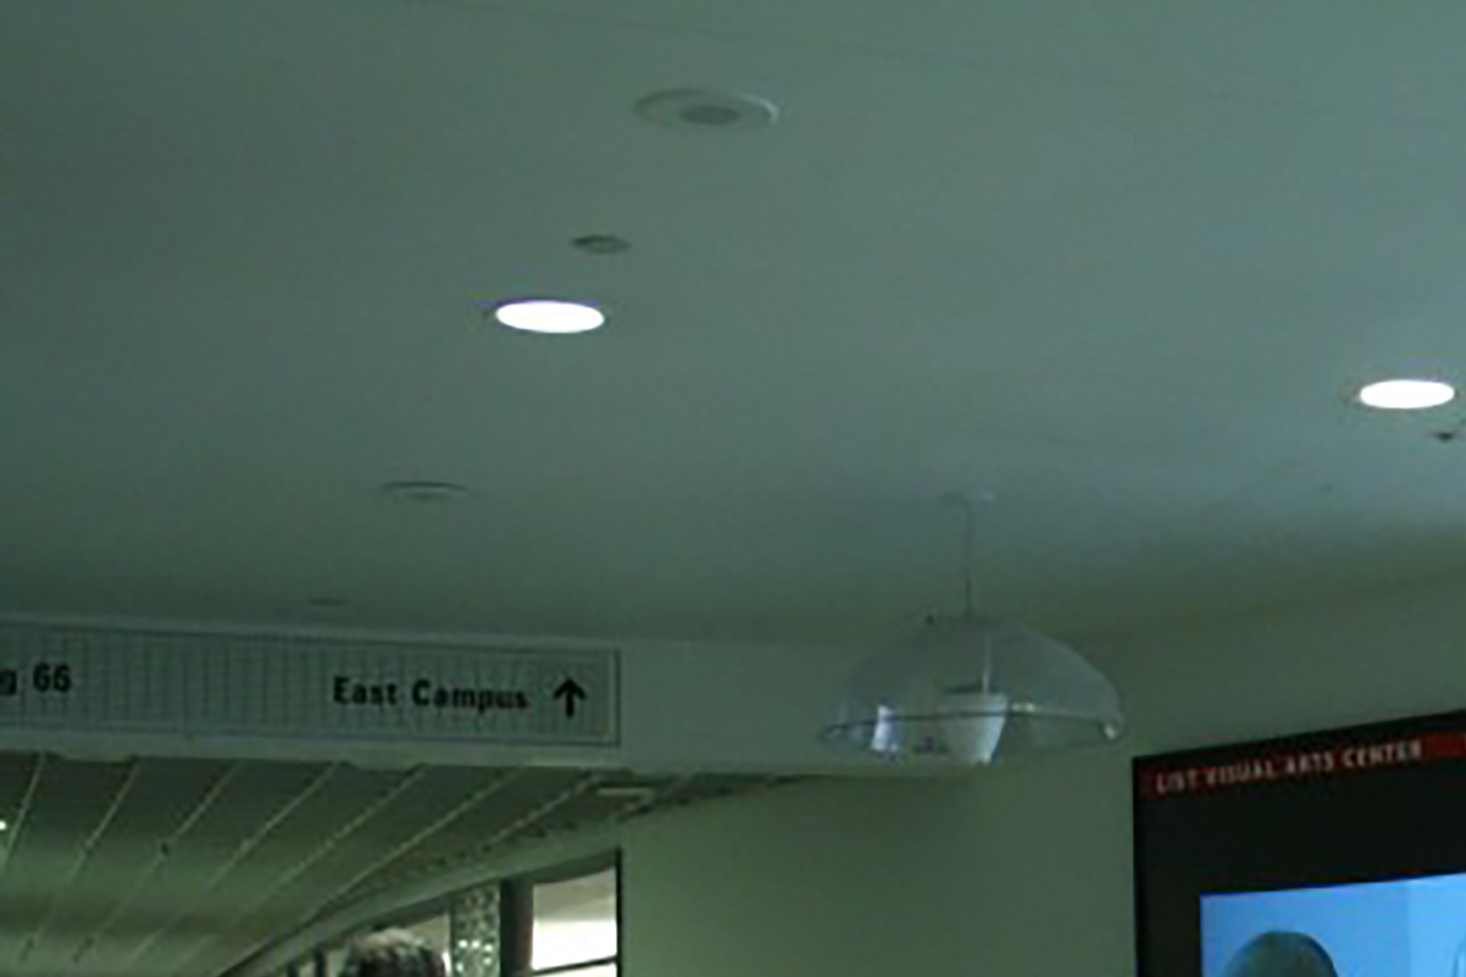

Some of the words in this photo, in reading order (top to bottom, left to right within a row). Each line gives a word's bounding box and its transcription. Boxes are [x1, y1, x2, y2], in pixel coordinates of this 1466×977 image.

[33, 662, 72, 693] 66
[333, 676, 397, 705] East
[411, 680, 528, 713] Campus
[1156, 770, 1197, 794] LIST
[1206, 759, 1274, 785] VISUAL
[1286, 751, 1333, 774] ARTS
[1342, 739, 1421, 768] CENTER
